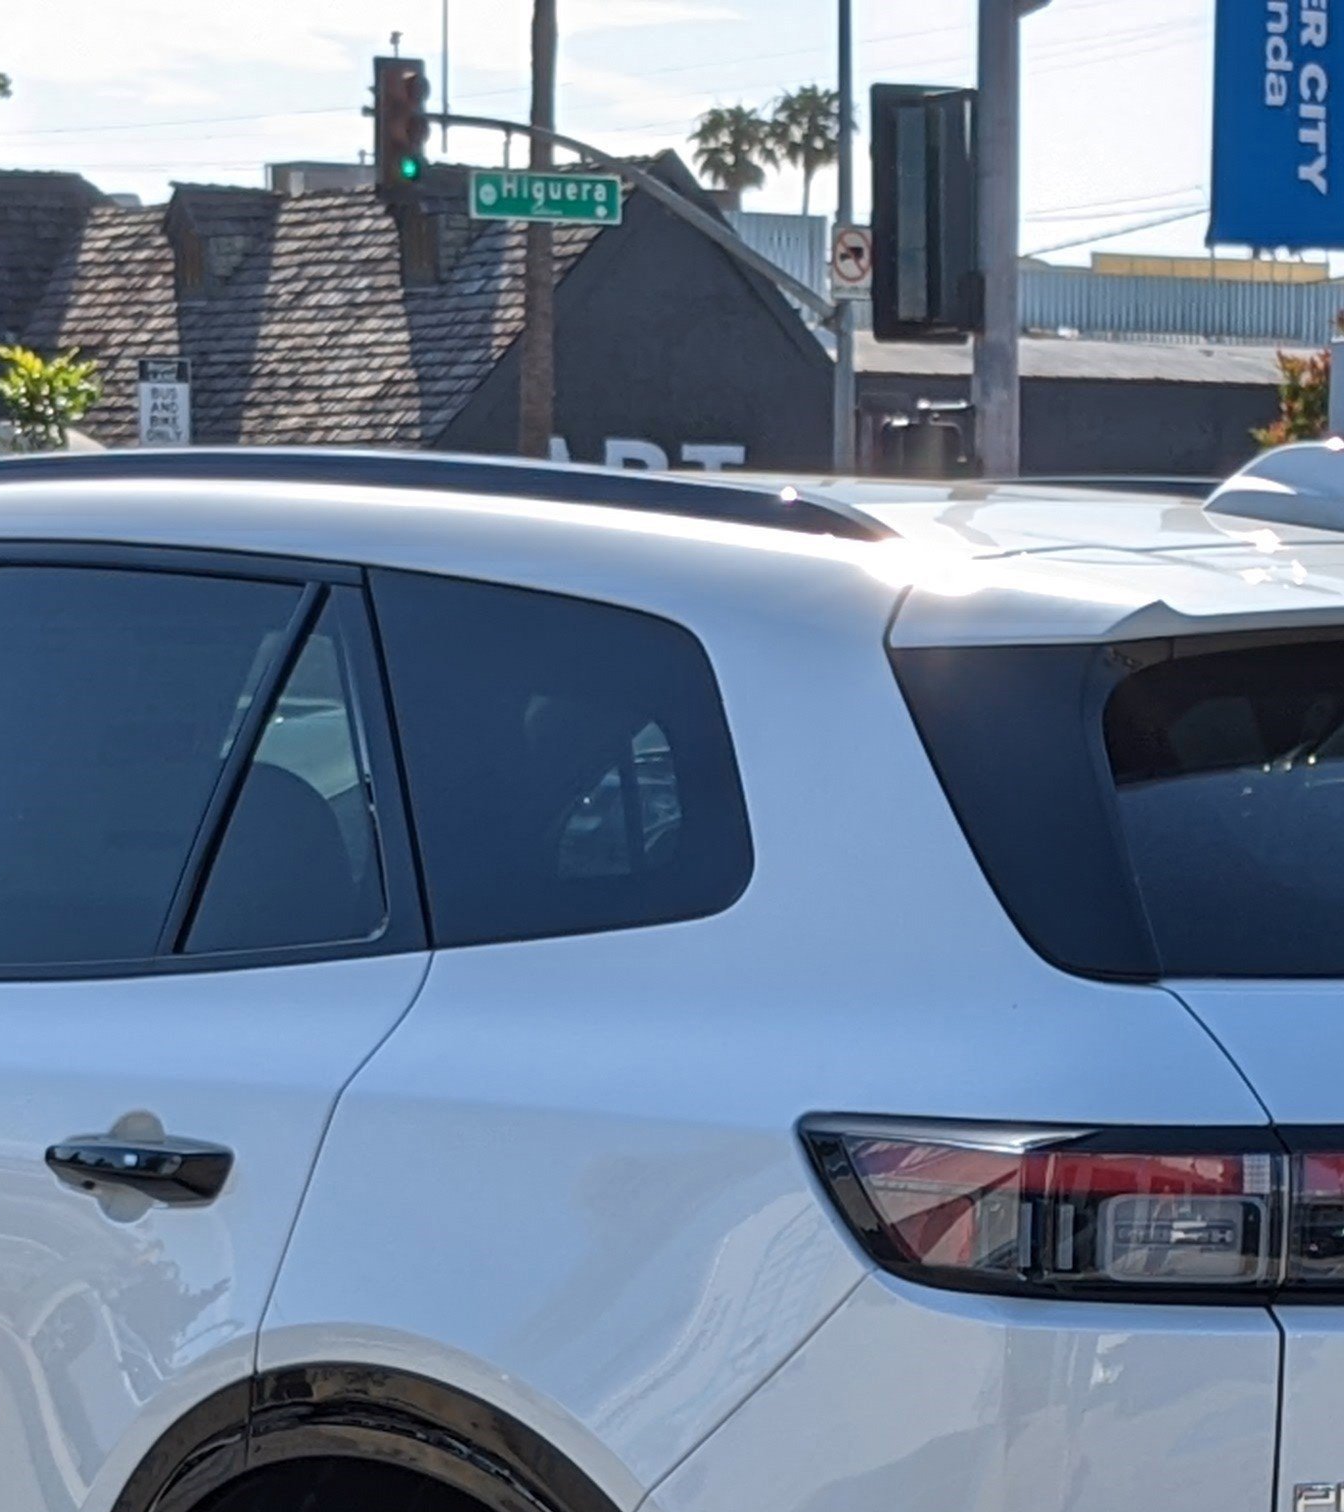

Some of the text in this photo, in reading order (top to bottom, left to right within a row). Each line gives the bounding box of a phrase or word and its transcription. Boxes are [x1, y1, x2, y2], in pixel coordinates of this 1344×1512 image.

[1298, 62, 1328, 195] CITY
[501, 175, 607, 207] Higuera
[150, 402, 179, 414] AND
